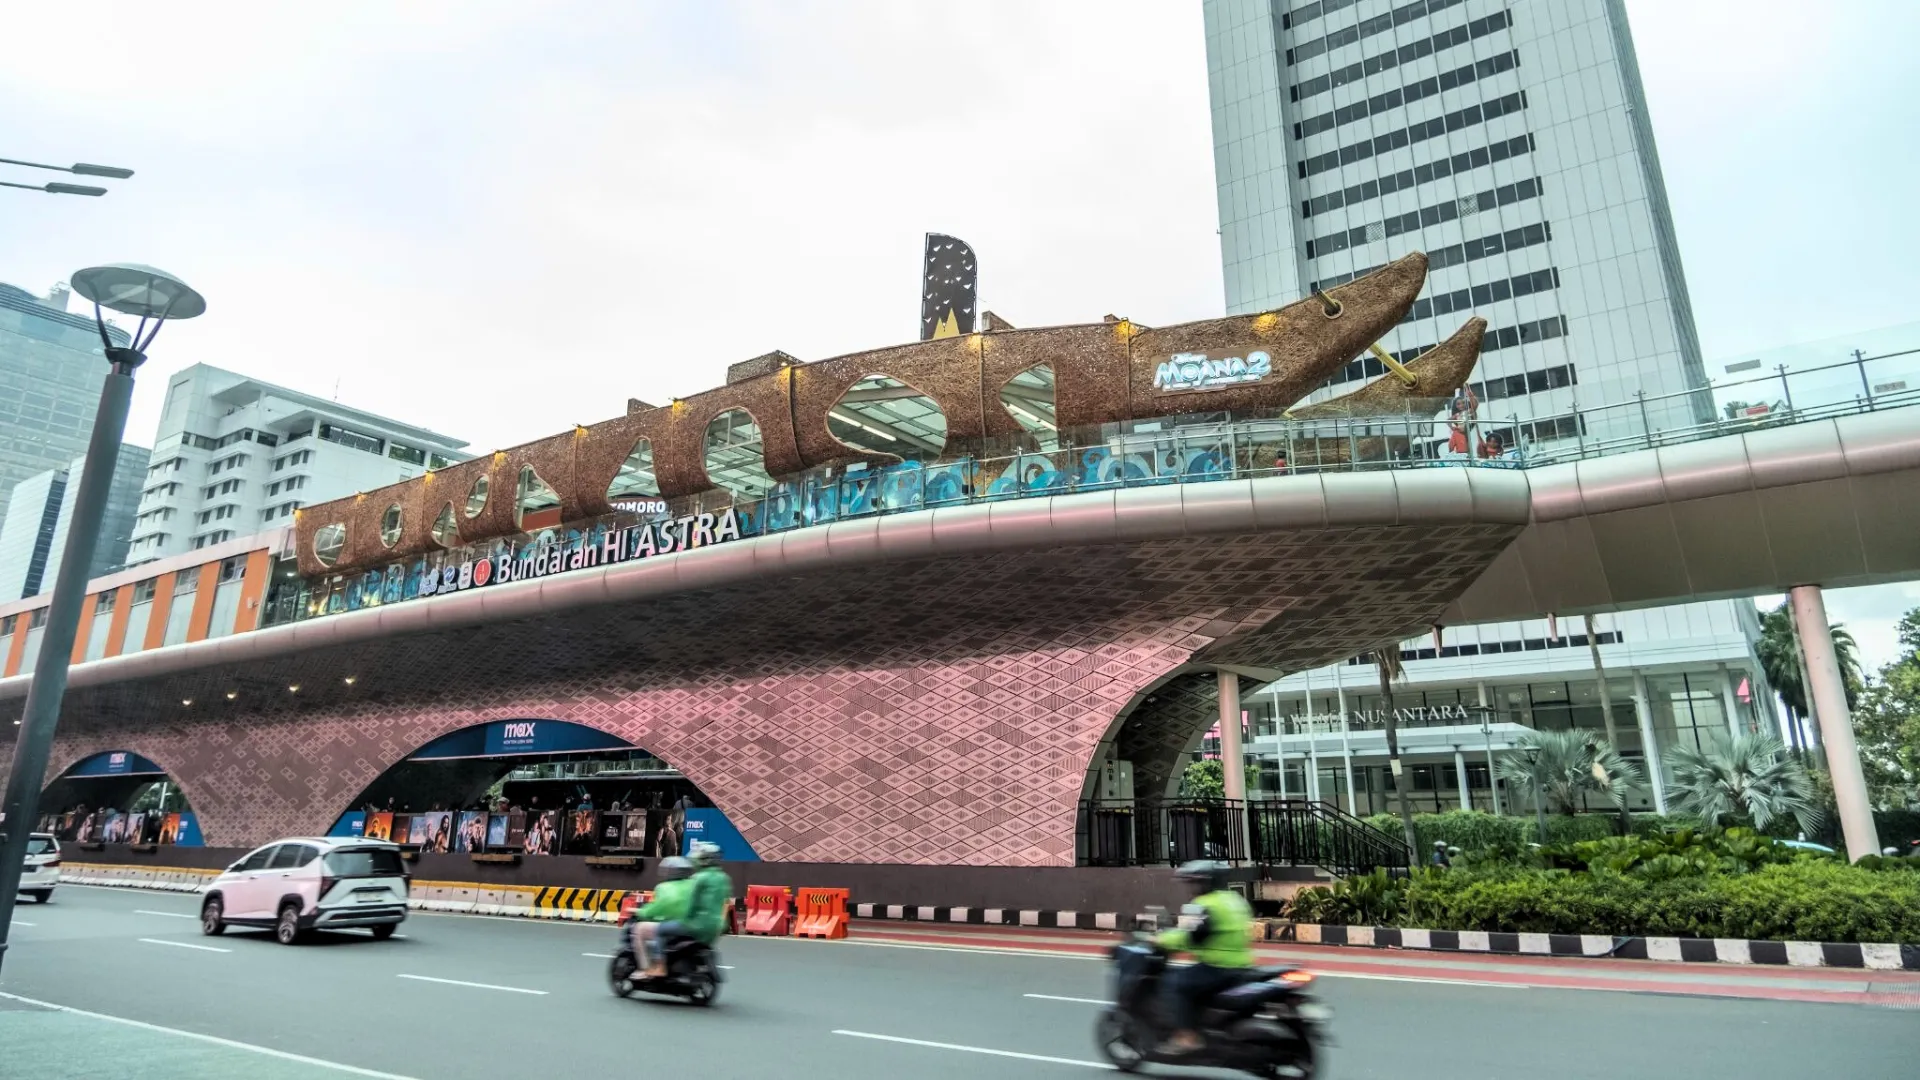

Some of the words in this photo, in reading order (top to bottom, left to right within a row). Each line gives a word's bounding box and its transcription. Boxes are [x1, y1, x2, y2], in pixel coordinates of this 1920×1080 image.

[1153, 357, 1247, 388] MOANA
[1247, 350, 1271, 376] 2
[497, 542, 597, 584] Bundaran
[601, 529, 628, 563] HI
[634, 508, 740, 558] ASTRA
[504, 722, 536, 738] max
[686, 820, 704, 829] max
